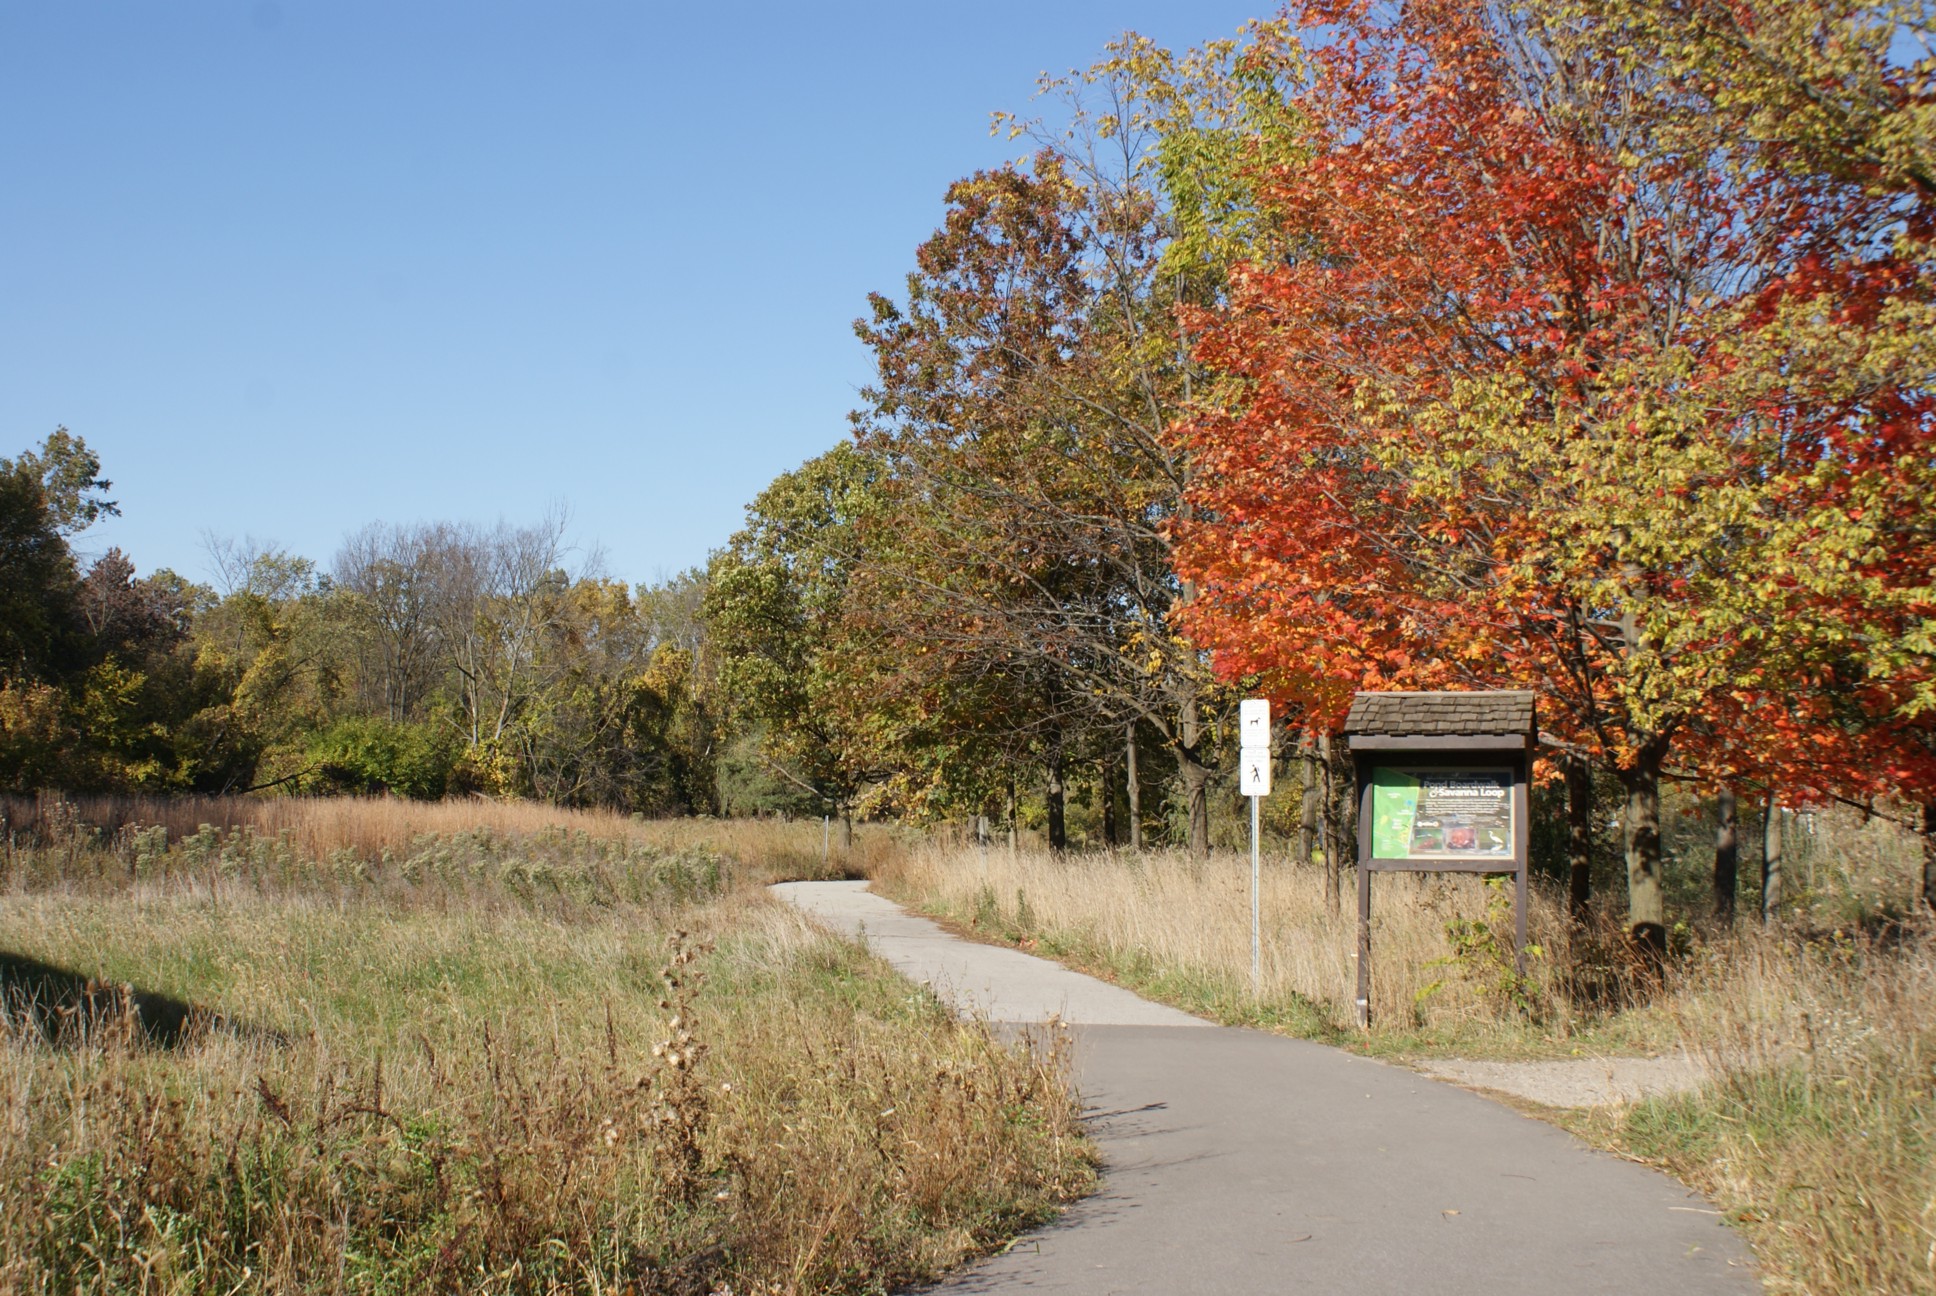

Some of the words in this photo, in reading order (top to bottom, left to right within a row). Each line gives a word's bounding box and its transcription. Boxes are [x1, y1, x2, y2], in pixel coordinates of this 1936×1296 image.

[1424, 780, 1447, 789] Pond
[1449, 780, 1500, 789] Boardwalk
[1439, 788, 1479, 797] Savanna
[1480, 788, 1505, 798] Loop
